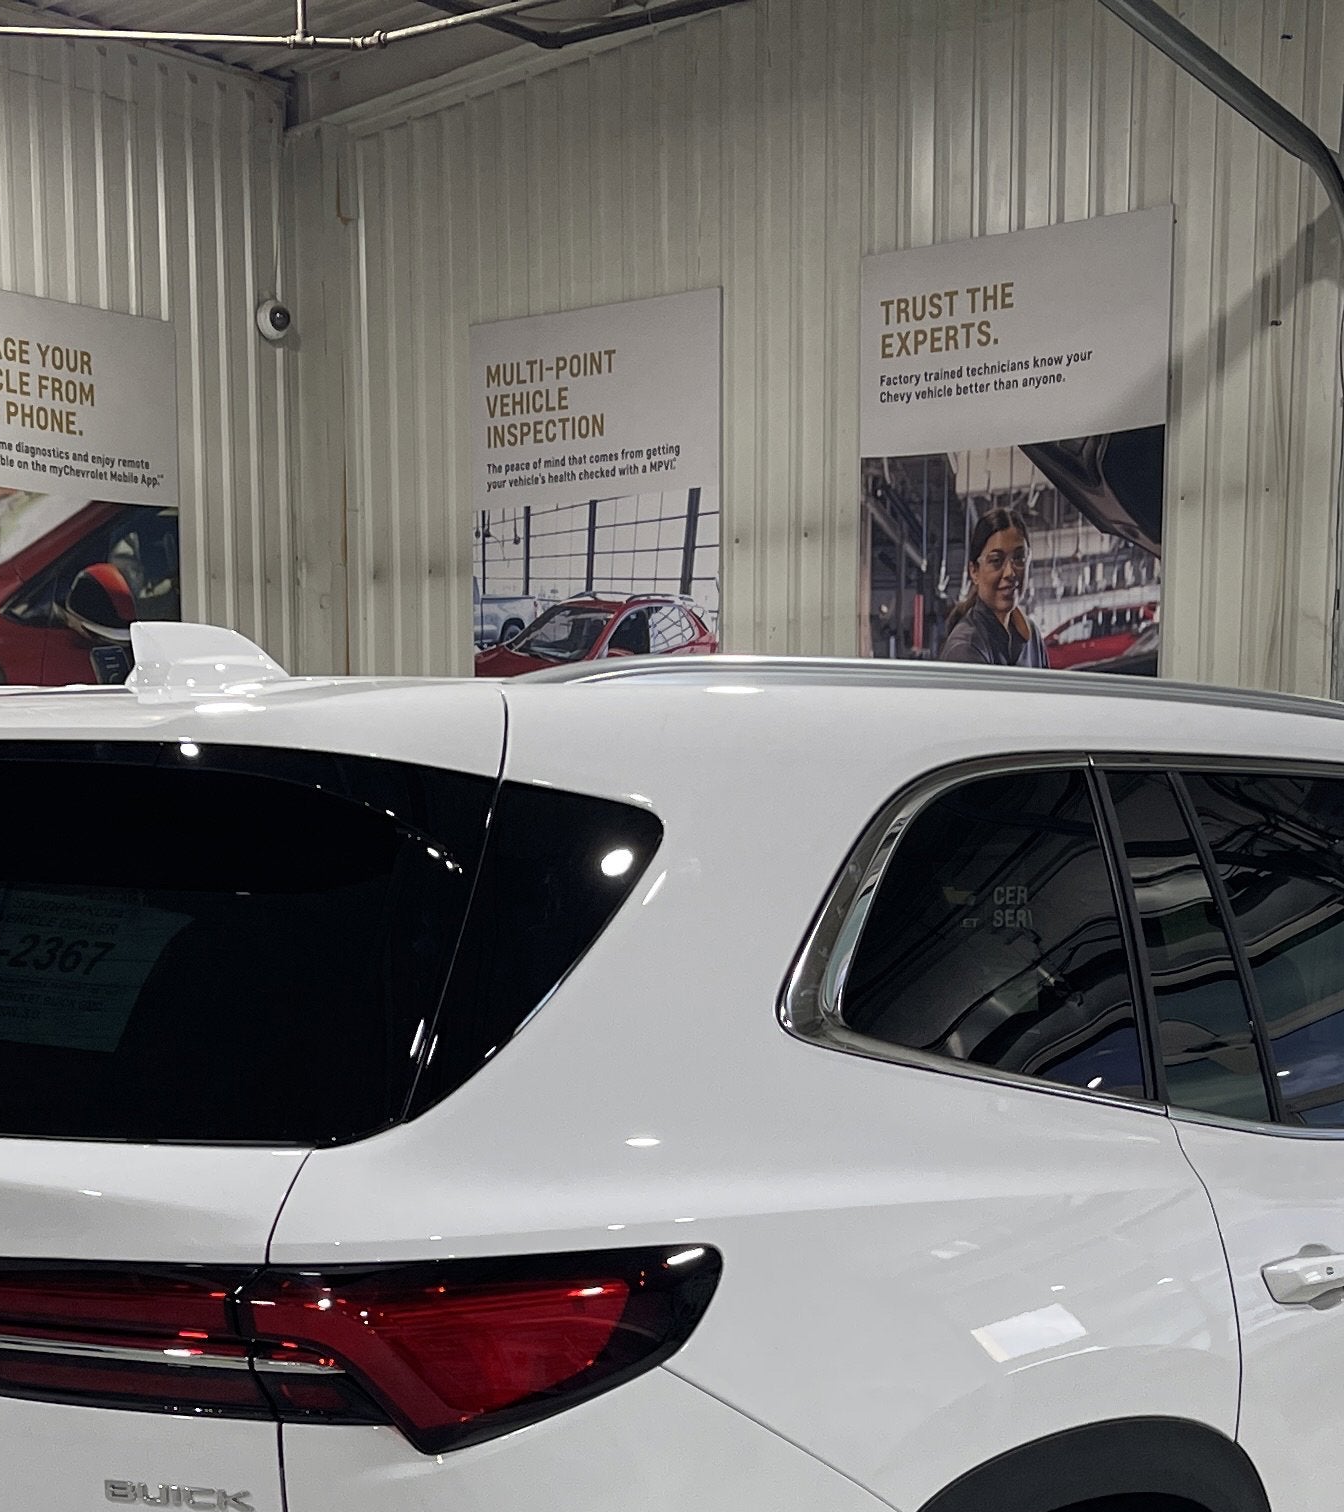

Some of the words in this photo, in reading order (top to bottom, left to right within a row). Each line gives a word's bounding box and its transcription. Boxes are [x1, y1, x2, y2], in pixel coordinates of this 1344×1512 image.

[879, 289, 960, 327] TRUST
[965, 281, 1015, 315] THE
[880, 320, 1000, 360] EXPERTS.
[35, 341, 94, 377] YOUR
[485, 348, 617, 389] MULTI-POINT
[879, 372, 921, 388] Factory
[923, 365, 964, 383] trained
[965, 357, 1031, 378] technicians
[1032, 354, 1064, 370] know
[1065, 350, 1094, 368] your
[37, 374, 96, 408] FROM
[485, 386, 570, 419] VEHICLE
[879, 390, 913, 405] Chevy
[914, 384, 954, 400] vehicle
[955, 379, 992, 397] better
[992, 376, 1020, 392] than
[1021, 372, 1067, 391] anyone.
[6, 400, 84, 437] PHONE.
[486, 413, 605, 449] INSPECTION
[15, 441, 71, 461] diagnostics
[71, 450, 90, 464] and
[90, 452, 116, 470] enjoy
[116, 457, 151, 471] remote
[16, 460, 30, 471] on
[30, 459, 48, 474] the
[48, 463, 109, 482] myChevrolet
[109, 470, 139, 485] Mobile
[486, 462, 503, 475] The
[503, 460, 531, 477] peace
[531, 457, 543, 470] of
[542, 454, 567, 469] mind
[567, 453, 588, 467] that
[588, 451, 619, 465] comes
[620, 447, 644, 461] from
[645, 442, 681, 461] getting
[486, 478, 507, 493] your
[508, 472, 546, 488] vehicle's
[547, 469, 577, 484] health
[578, 464, 617, 481] checked
[618, 463, 640, 477] with
[640, 463, 648, 475] a
